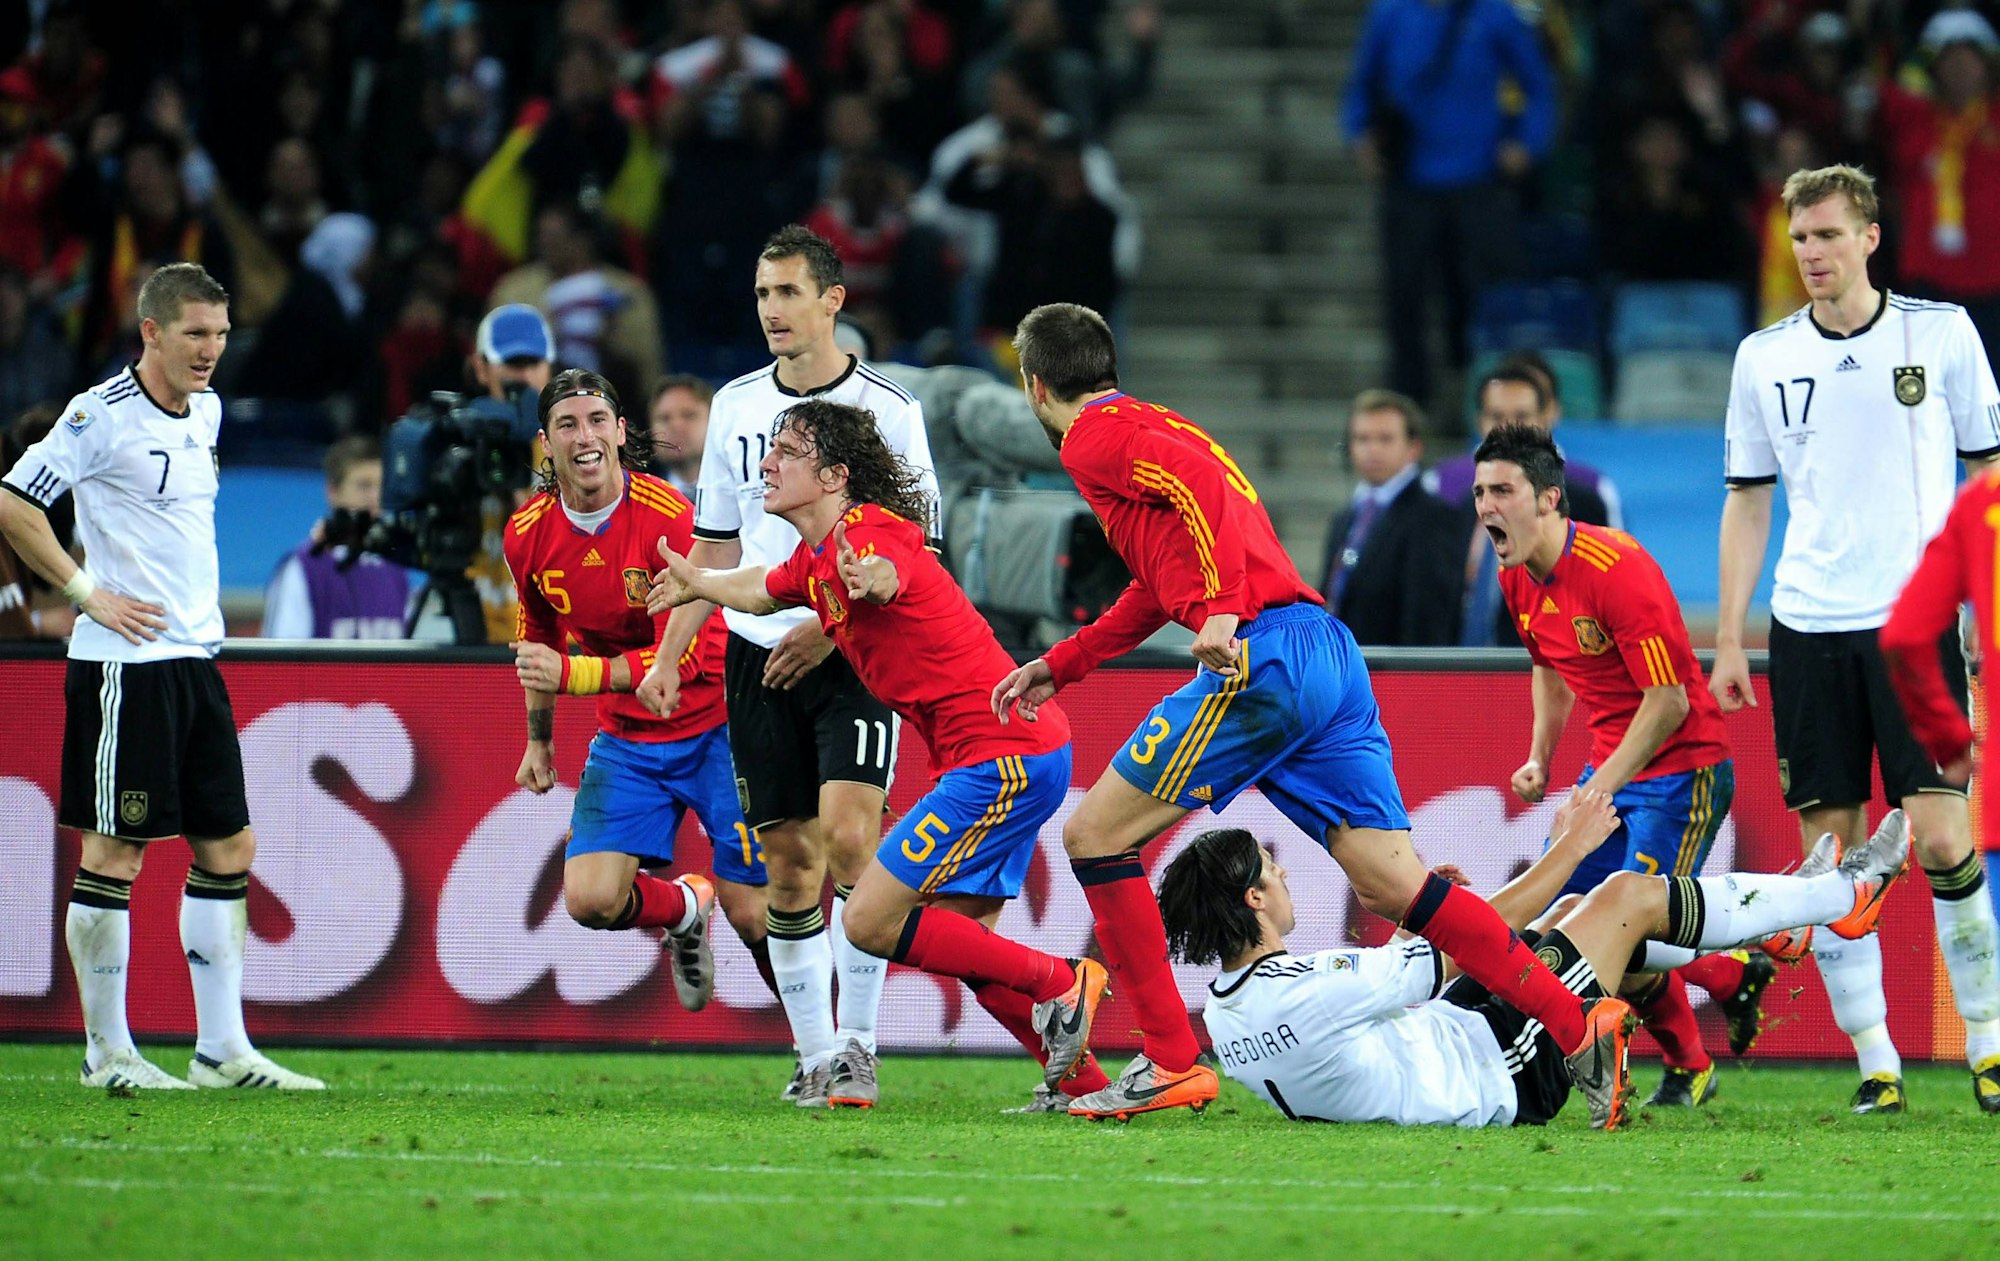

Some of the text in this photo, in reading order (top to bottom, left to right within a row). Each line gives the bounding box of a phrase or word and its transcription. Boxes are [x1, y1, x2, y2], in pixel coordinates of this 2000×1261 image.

[1774, 377, 1816, 427] 17
[148, 449, 170, 494] 7
[737, 432, 766, 482] 11
[532, 569, 572, 615] 5
[853, 718, 887, 769] 11
[1129, 715, 1171, 765] 3
[900, 811, 951, 863] 5
[1216, 1024, 1300, 1069] HEDIRA
